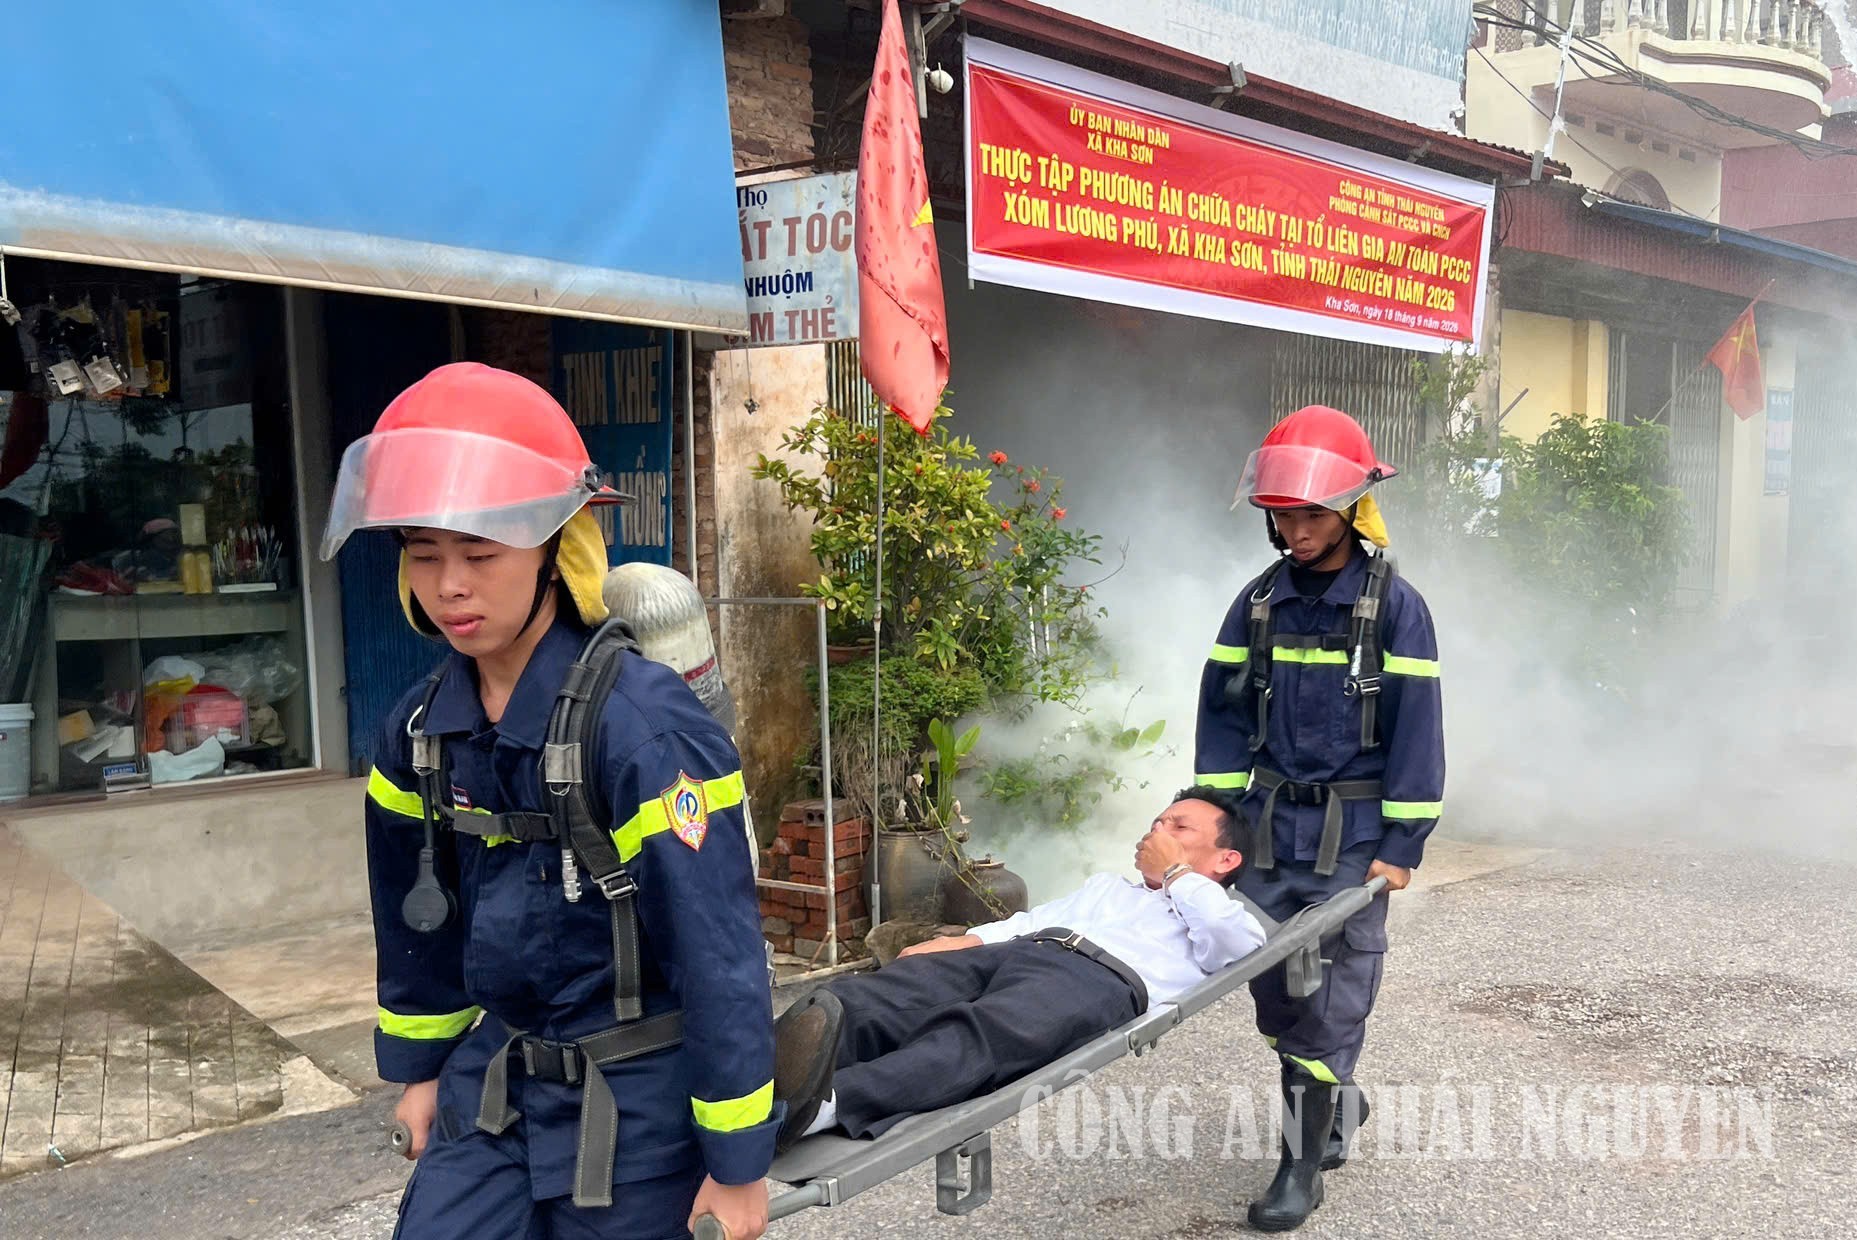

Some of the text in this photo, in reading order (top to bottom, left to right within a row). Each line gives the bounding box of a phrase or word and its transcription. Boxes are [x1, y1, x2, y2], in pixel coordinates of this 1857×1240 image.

[1069, 103, 1170, 148] ỦY BAN NHÂN DÂN
[1087, 132, 1153, 165] XÃ KHA SƠN
[979, 142, 1471, 284] THỰC TẬP PHƯƠNG ÁN CHỮA CHÁY TẠI TỔ LIÊN GIA AN TOÀN PCCC
[1329, 195, 1451, 240] PHÒNG CẢNH SÁT PCCC VÀ CNCH
[1339, 179, 1445, 222] CÔNG AN TỈNH THÁI NGUYÊN
[783, 201, 853, 257] TÓC
[1003, 189, 1455, 312] XÓM LƯƠNG PHÚ, XÃ KHA SƠN, TỈNH THÁI NGUYÊN NĂM 2026
[744, 269, 813, 299] NHUỘM
[784, 294, 837, 340] THẺ
[1325, 296, 1341, 309] Kha
[1343, 300, 1360, 315] Sơn,
[1362, 304, 1383, 320] ngày
[1384, 308, 1393, 320] 18
[1394, 311, 1416, 328] tháng
[1417, 315, 1422, 326] 9
[1422, 317, 1440, 330] năm
